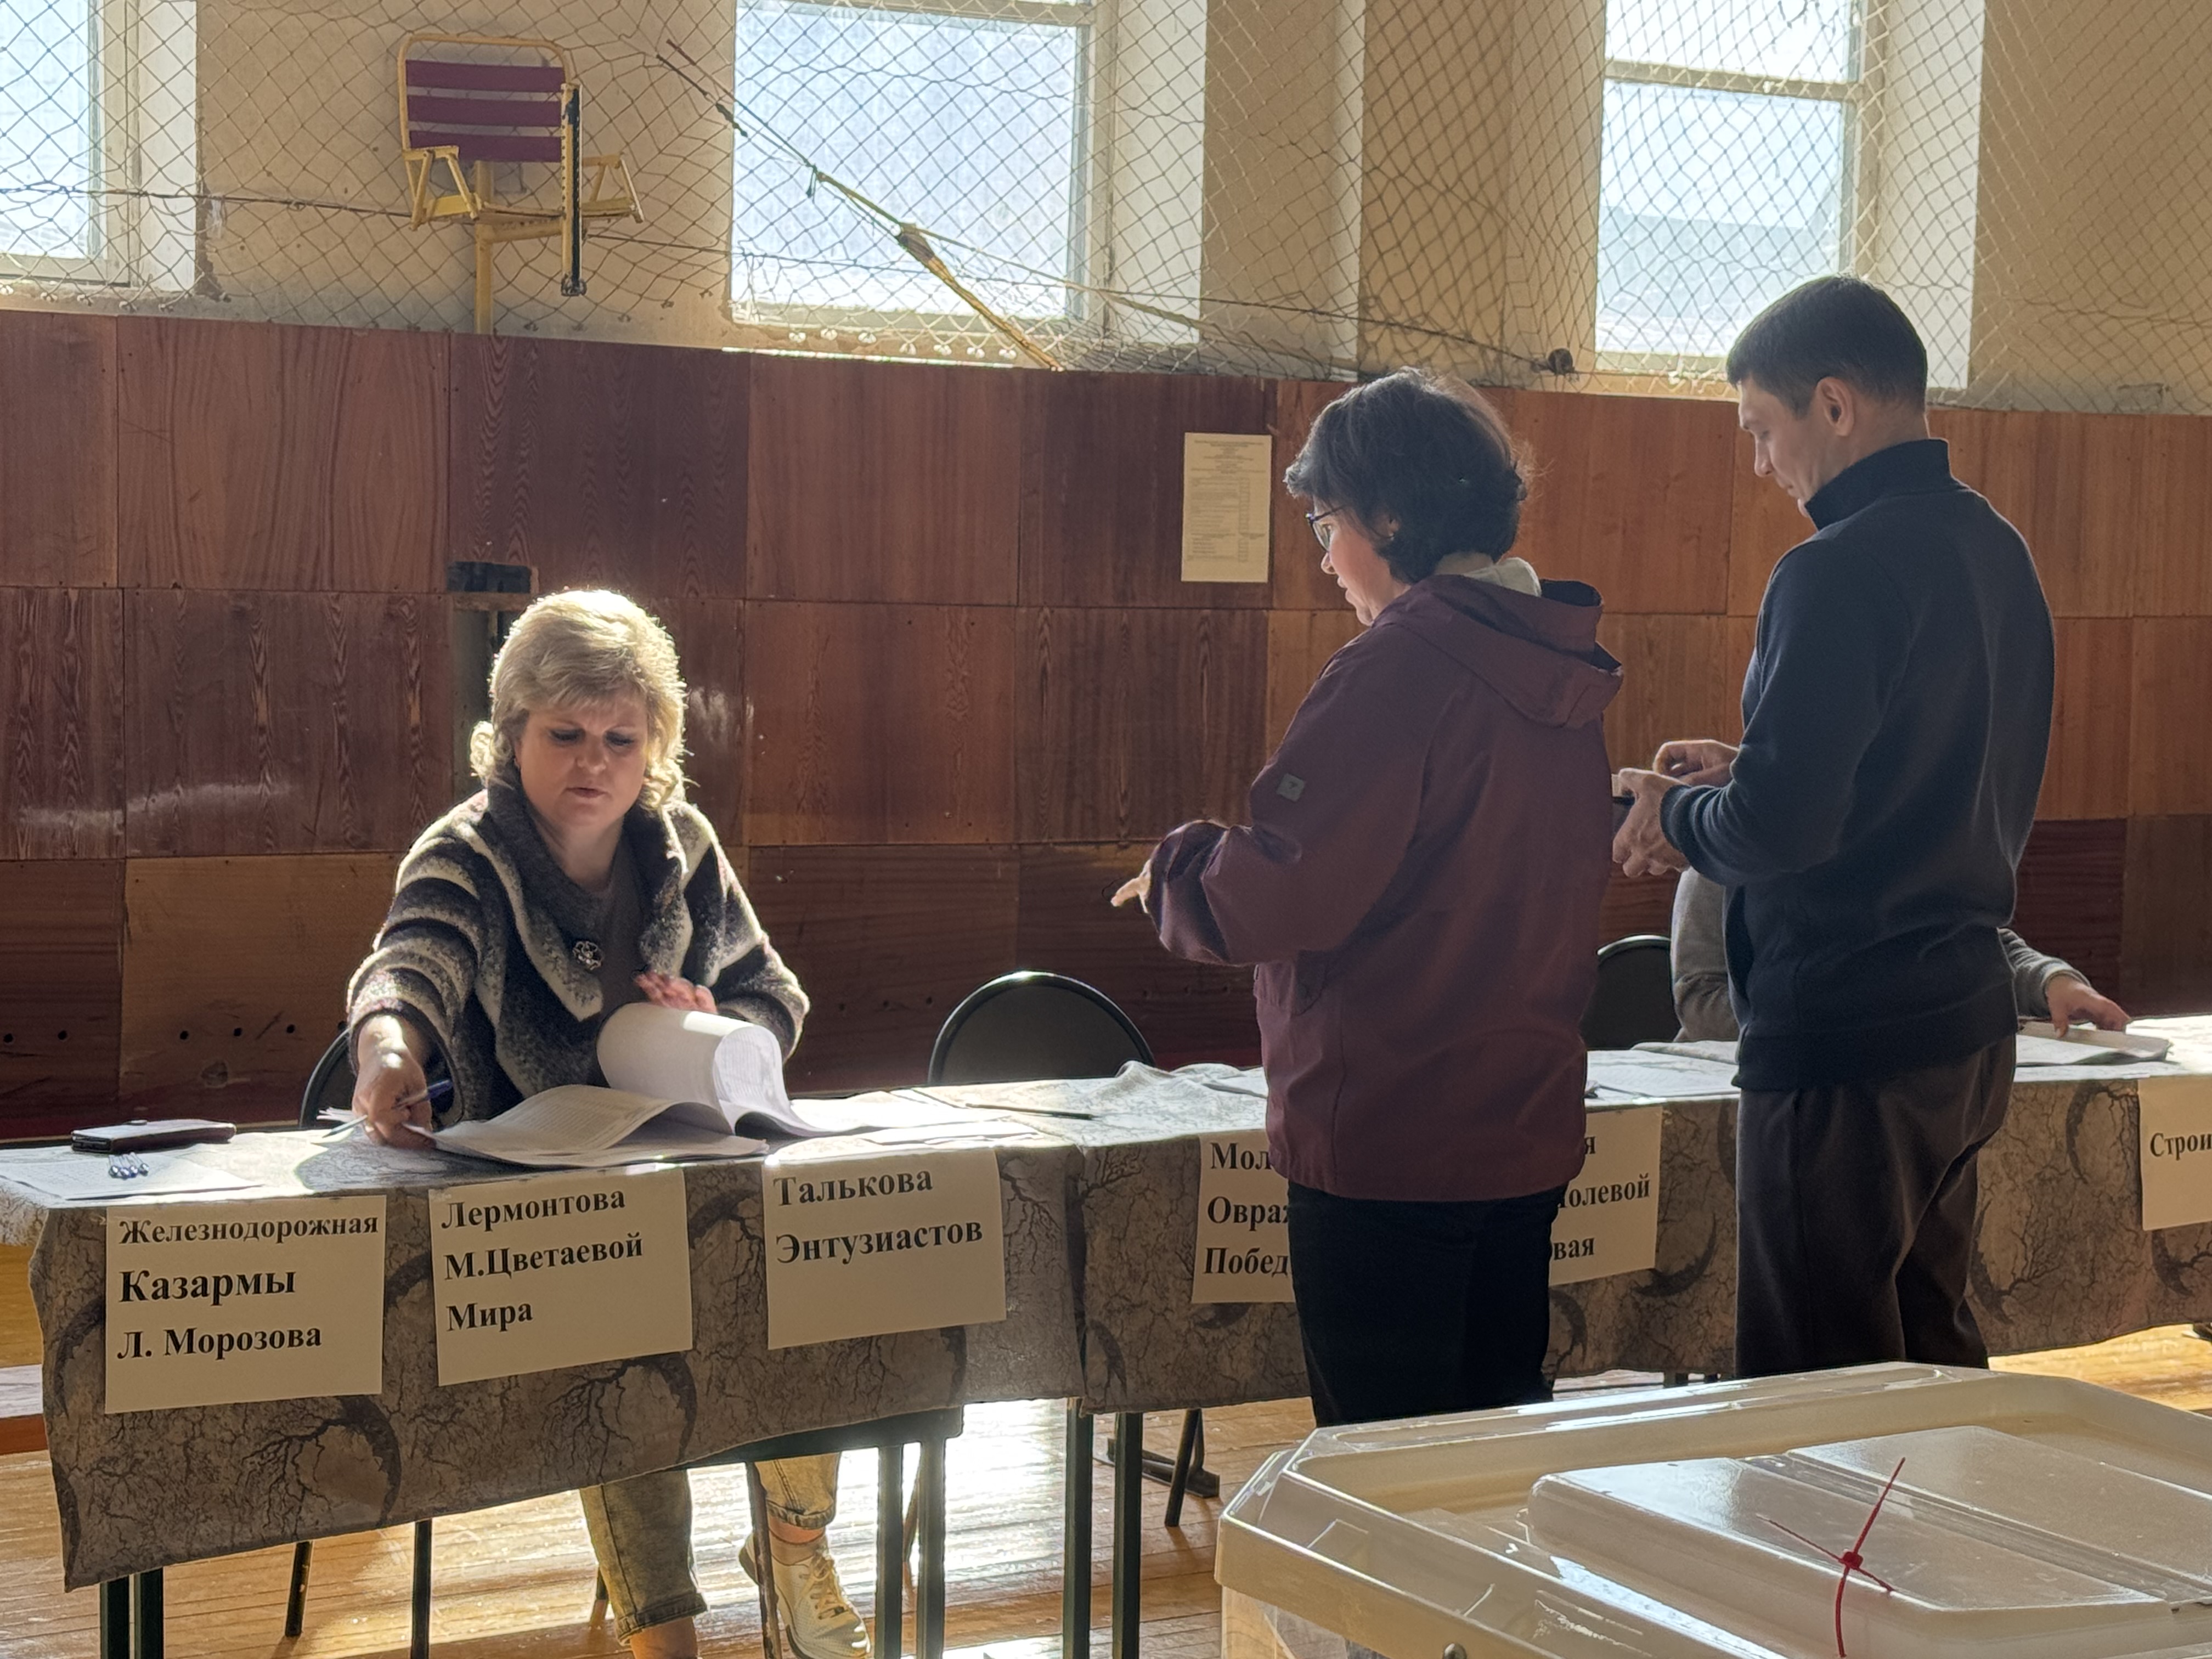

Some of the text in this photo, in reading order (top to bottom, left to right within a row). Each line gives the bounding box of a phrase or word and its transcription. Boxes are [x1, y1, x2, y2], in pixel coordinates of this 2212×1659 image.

[1210, 1142, 1271, 1170] Мол
[2150, 1132, 2212, 1161] Строи
[774, 1170, 933, 1206] Талькова
[1559, 1172, 1650, 1208] олевой
[441, 1190, 626, 1232] Лермонтова
[119, 1216, 379, 1244] Железнодорожная
[776, 1220, 983, 1265] Энтузиастов
[444, 1233, 643, 1280] М.Цветаевой
[1204, 1247, 1289, 1277] Побед
[1553, 1237, 1595, 1261] вая
[119, 1269, 297, 1306] Казармы
[445, 1300, 534, 1333] Мира
[117, 1327, 322, 1361] Л. Морозова
